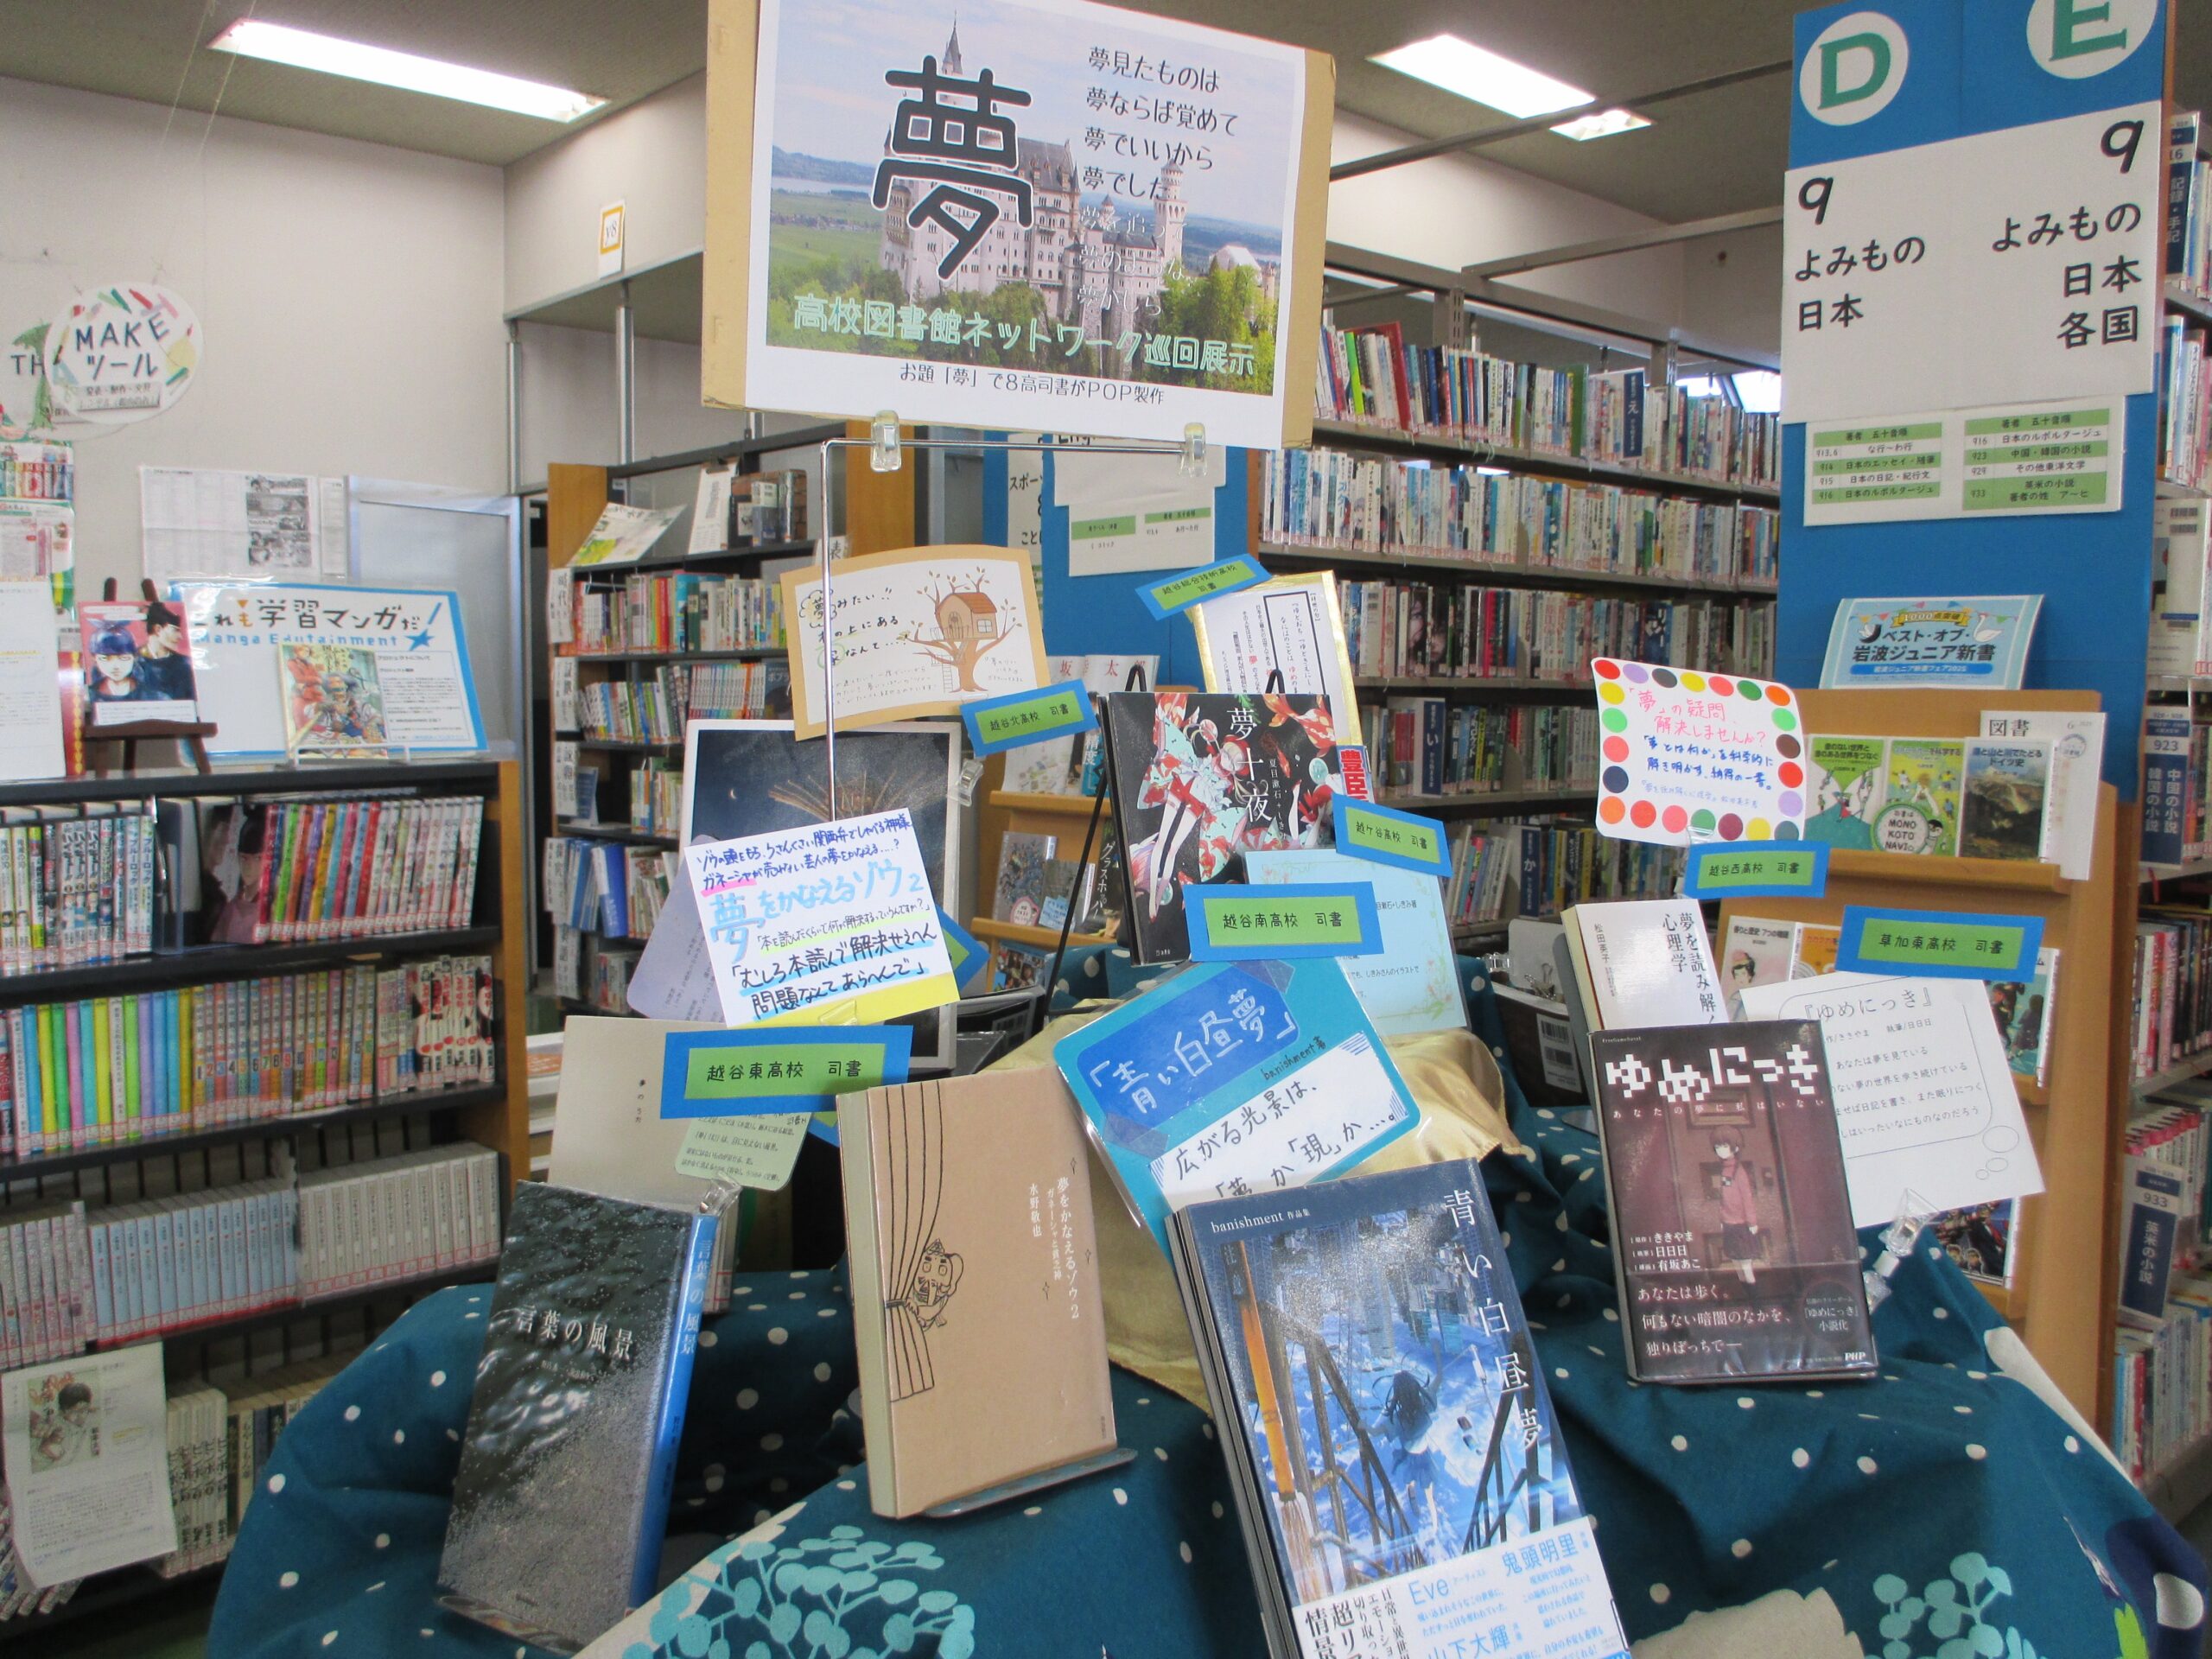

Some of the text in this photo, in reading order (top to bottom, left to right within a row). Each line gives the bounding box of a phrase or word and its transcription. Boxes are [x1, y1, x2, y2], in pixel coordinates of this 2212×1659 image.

[2048, 0, 2127, 61] E
[1089, 47, 1219, 92] 夢見たものは
[1818, 32, 1891, 110] D
[1087, 86, 1238, 137] 夢ならば覚めて
[1085, 127, 1213, 170] 夢でいいから
[2101, 120, 2145, 173] 9
[871, 54, 1033, 282] 夢
[1084, 166, 1167, 200] 夢でした
[1798, 177, 1834, 225] 9
[1993, 202, 2141, 252] よみもの
[1795, 237, 1925, 282] よみもの
[2063, 255, 2142, 297] 日本
[1799, 294, 1864, 332] 日本
[2057, 305, 2139, 349] 各国
[75, 312, 170, 352] MAKE
[793, 294, 1255, 377] 高校図書館ネットワーク巡回展示
[87, 353, 159, 380] ツール
[2002, 429, 2102, 443] 日本のルポルタージュ
[1816, 448, 1838, 457] 913.6
[1846, 455, 1936, 470] 日本のエッセイ・随筆
[1972, 444, 2092, 461] 923 中国・韓国の小説
[1850, 471, 1931, 484] 日本の日記・紀行文
[1846, 486, 1934, 499] 日本のルポルタージュ
[1199, 582, 1217, 593] 司書
[1852, 643, 1997, 662] 岩波ジュニア新書
[990, 703, 1070, 732] 越谷北高校 司書
[1990, 719, 2030, 737] 図書
[2153, 740, 2179, 752] 923
[1227, 708, 1274, 823] 夢十夜
[1341, 749, 1369, 802] 豊臣
[1887, 830, 1915, 840] KOTO
[1888, 819, 1916, 830] MONO
[1410, 835, 1427, 849] 司書
[1709, 861, 1800, 875] 越谷西高校 司書
[1223, 912, 1342, 930] 越谷南高校 司書
[1662, 913, 1688, 973] 心理学
[1878, 934, 2004, 955] 草加東高校 司書
[1090, 988, 1297, 1114] 「青い白昼夢」
[1836, 1046, 1929, 1071] あなたは夢を見ている
[706, 1059, 862, 1083] 越谷東高校 司書
[1605, 1044, 1820, 1103] ゆめにっき
[1612, 1098, 1825, 1120] あなたの夢に私はいない
[1175, 1080, 1318, 1180] 広がる光景は、
[2143, 1192, 2168, 1208] 933
[1211, 1211, 1285, 1234] banishment
[1656, 1244, 1688, 1257] 日日日
[1637, 1284, 1729, 1301] あなたは歩く。
[518, 1303, 634, 1361] 言葉の風景
[1444, 1188, 1544, 1452] 青い白昼夢
[1819, 1319, 1850, 1332] 小説化
[1844, 1351, 1866, 1362] PHP
[1502, 1534, 1580, 1578] 鬼頭明里
[1408, 1576, 1451, 1605] Eve
[1353, 1595, 1380, 1659] 切り取っ
